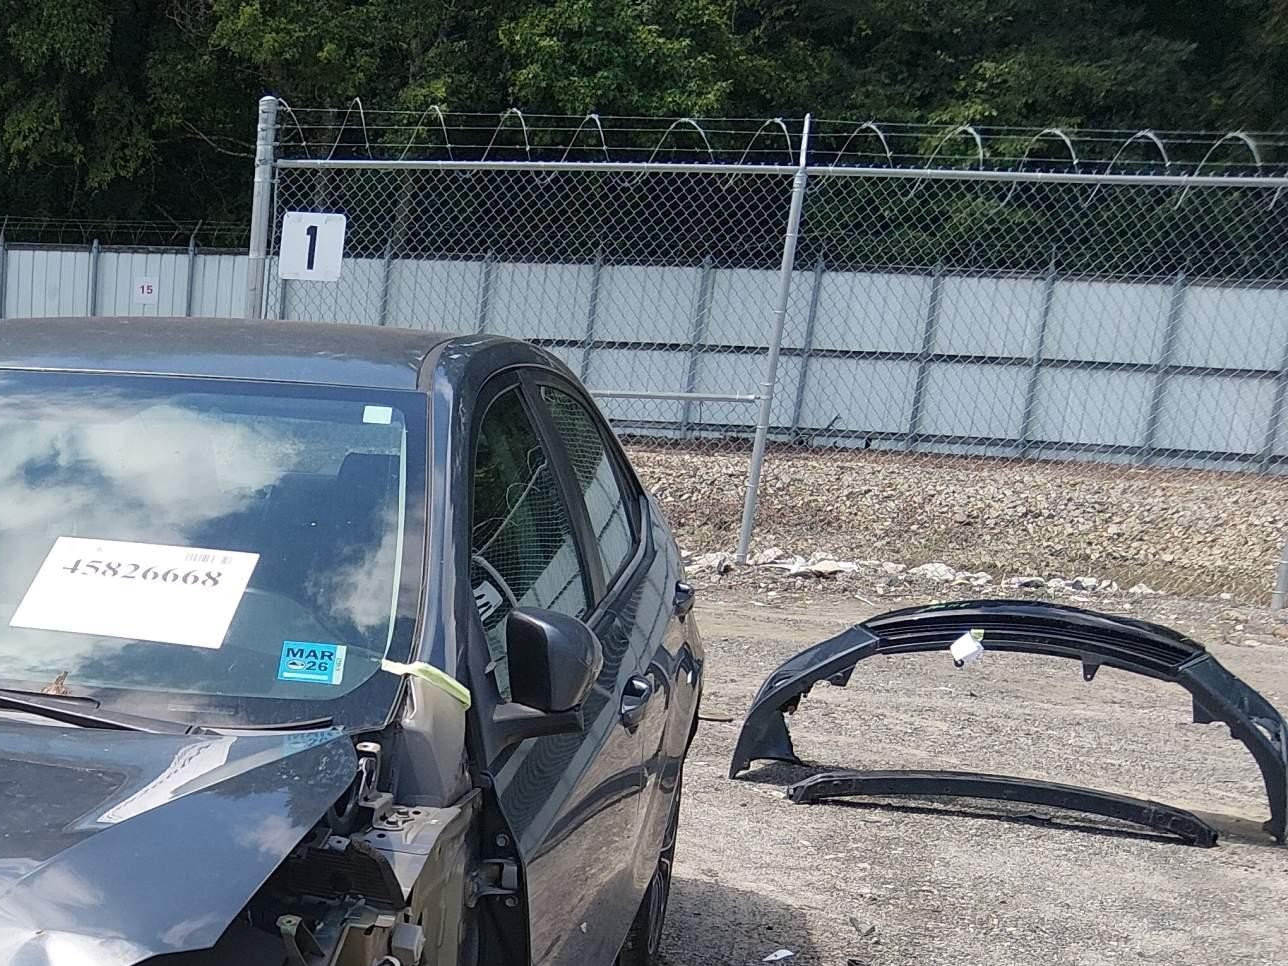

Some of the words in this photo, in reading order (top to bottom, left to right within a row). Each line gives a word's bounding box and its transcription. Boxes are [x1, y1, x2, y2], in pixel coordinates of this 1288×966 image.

[306, 225, 318, 270] 1
[140, 285, 153, 294] 15
[62, 558, 222, 587] 45826668
[286, 647, 334, 661] MAR
[306, 661, 328, 672] 26
